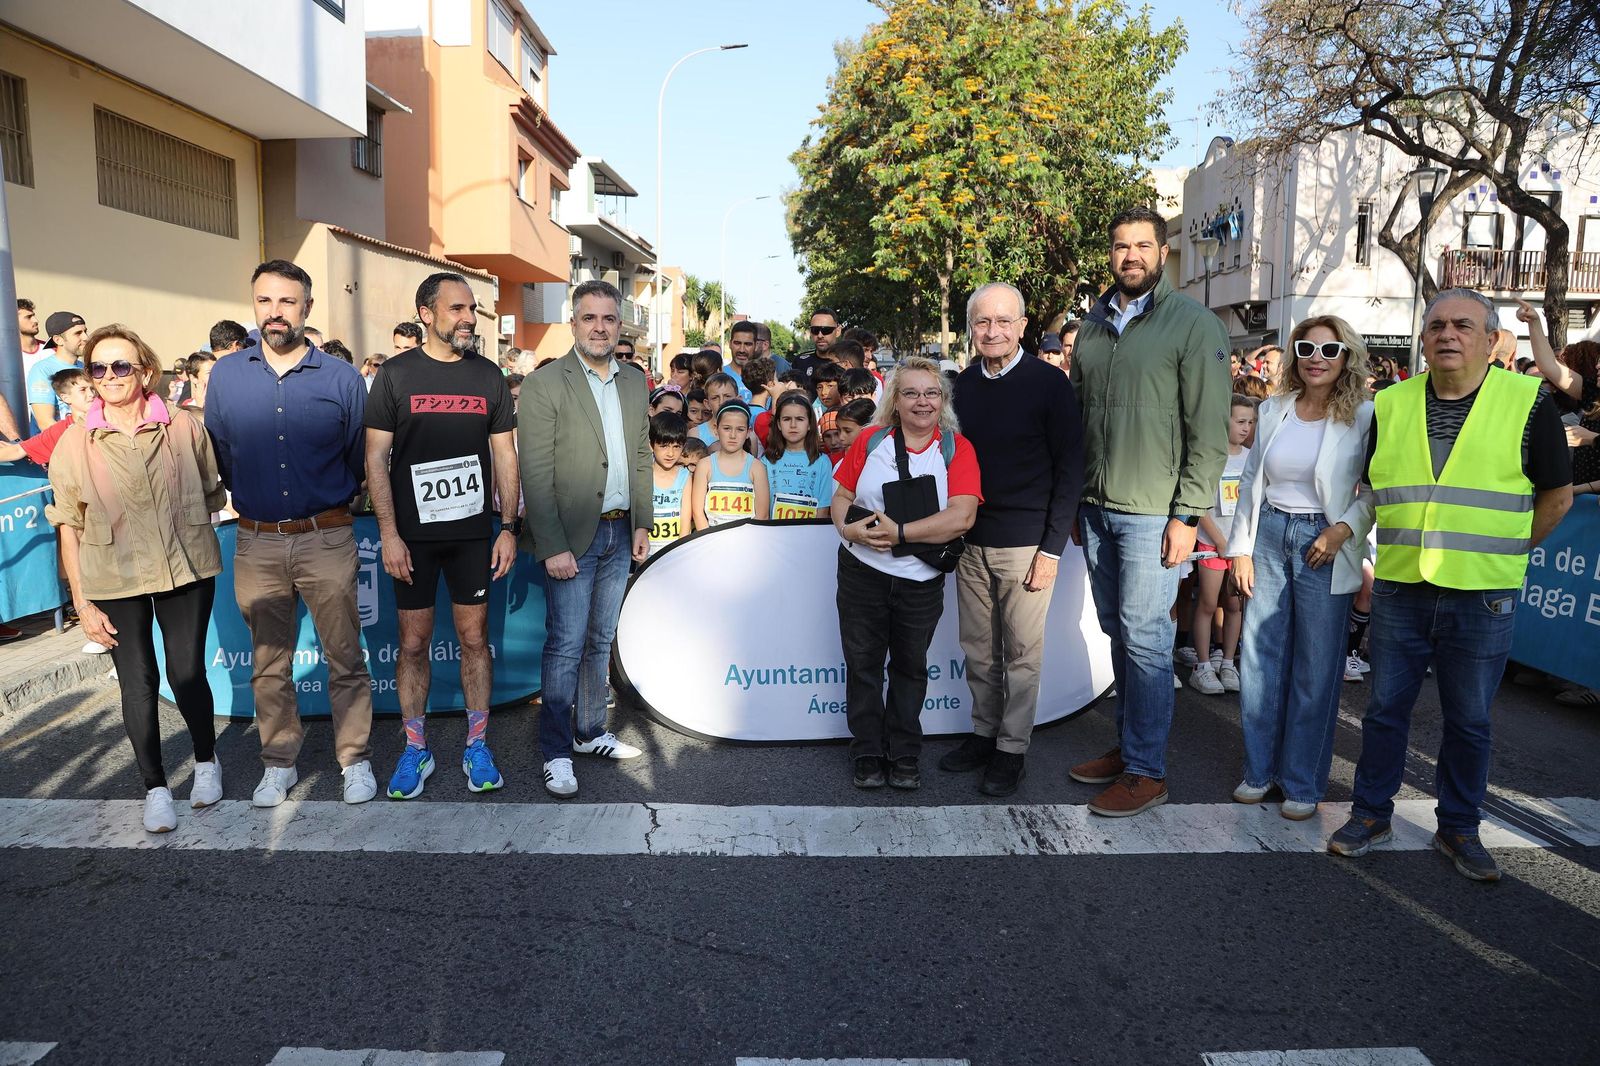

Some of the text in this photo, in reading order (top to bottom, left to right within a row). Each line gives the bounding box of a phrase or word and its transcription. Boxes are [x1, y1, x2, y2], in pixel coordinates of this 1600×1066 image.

[415, 398, 484, 410] アシックス
[420, 473, 480, 503] 2014
[710, 495, 752, 513] 1141
[648, 522, 680, 538] 031
[1555, 547, 1586, 576] de
[1520, 576, 1576, 619] laga
[724, 663, 847, 690] Ayuntami
[295, 680, 322, 692] rea
[924, 696, 961, 712] orte
